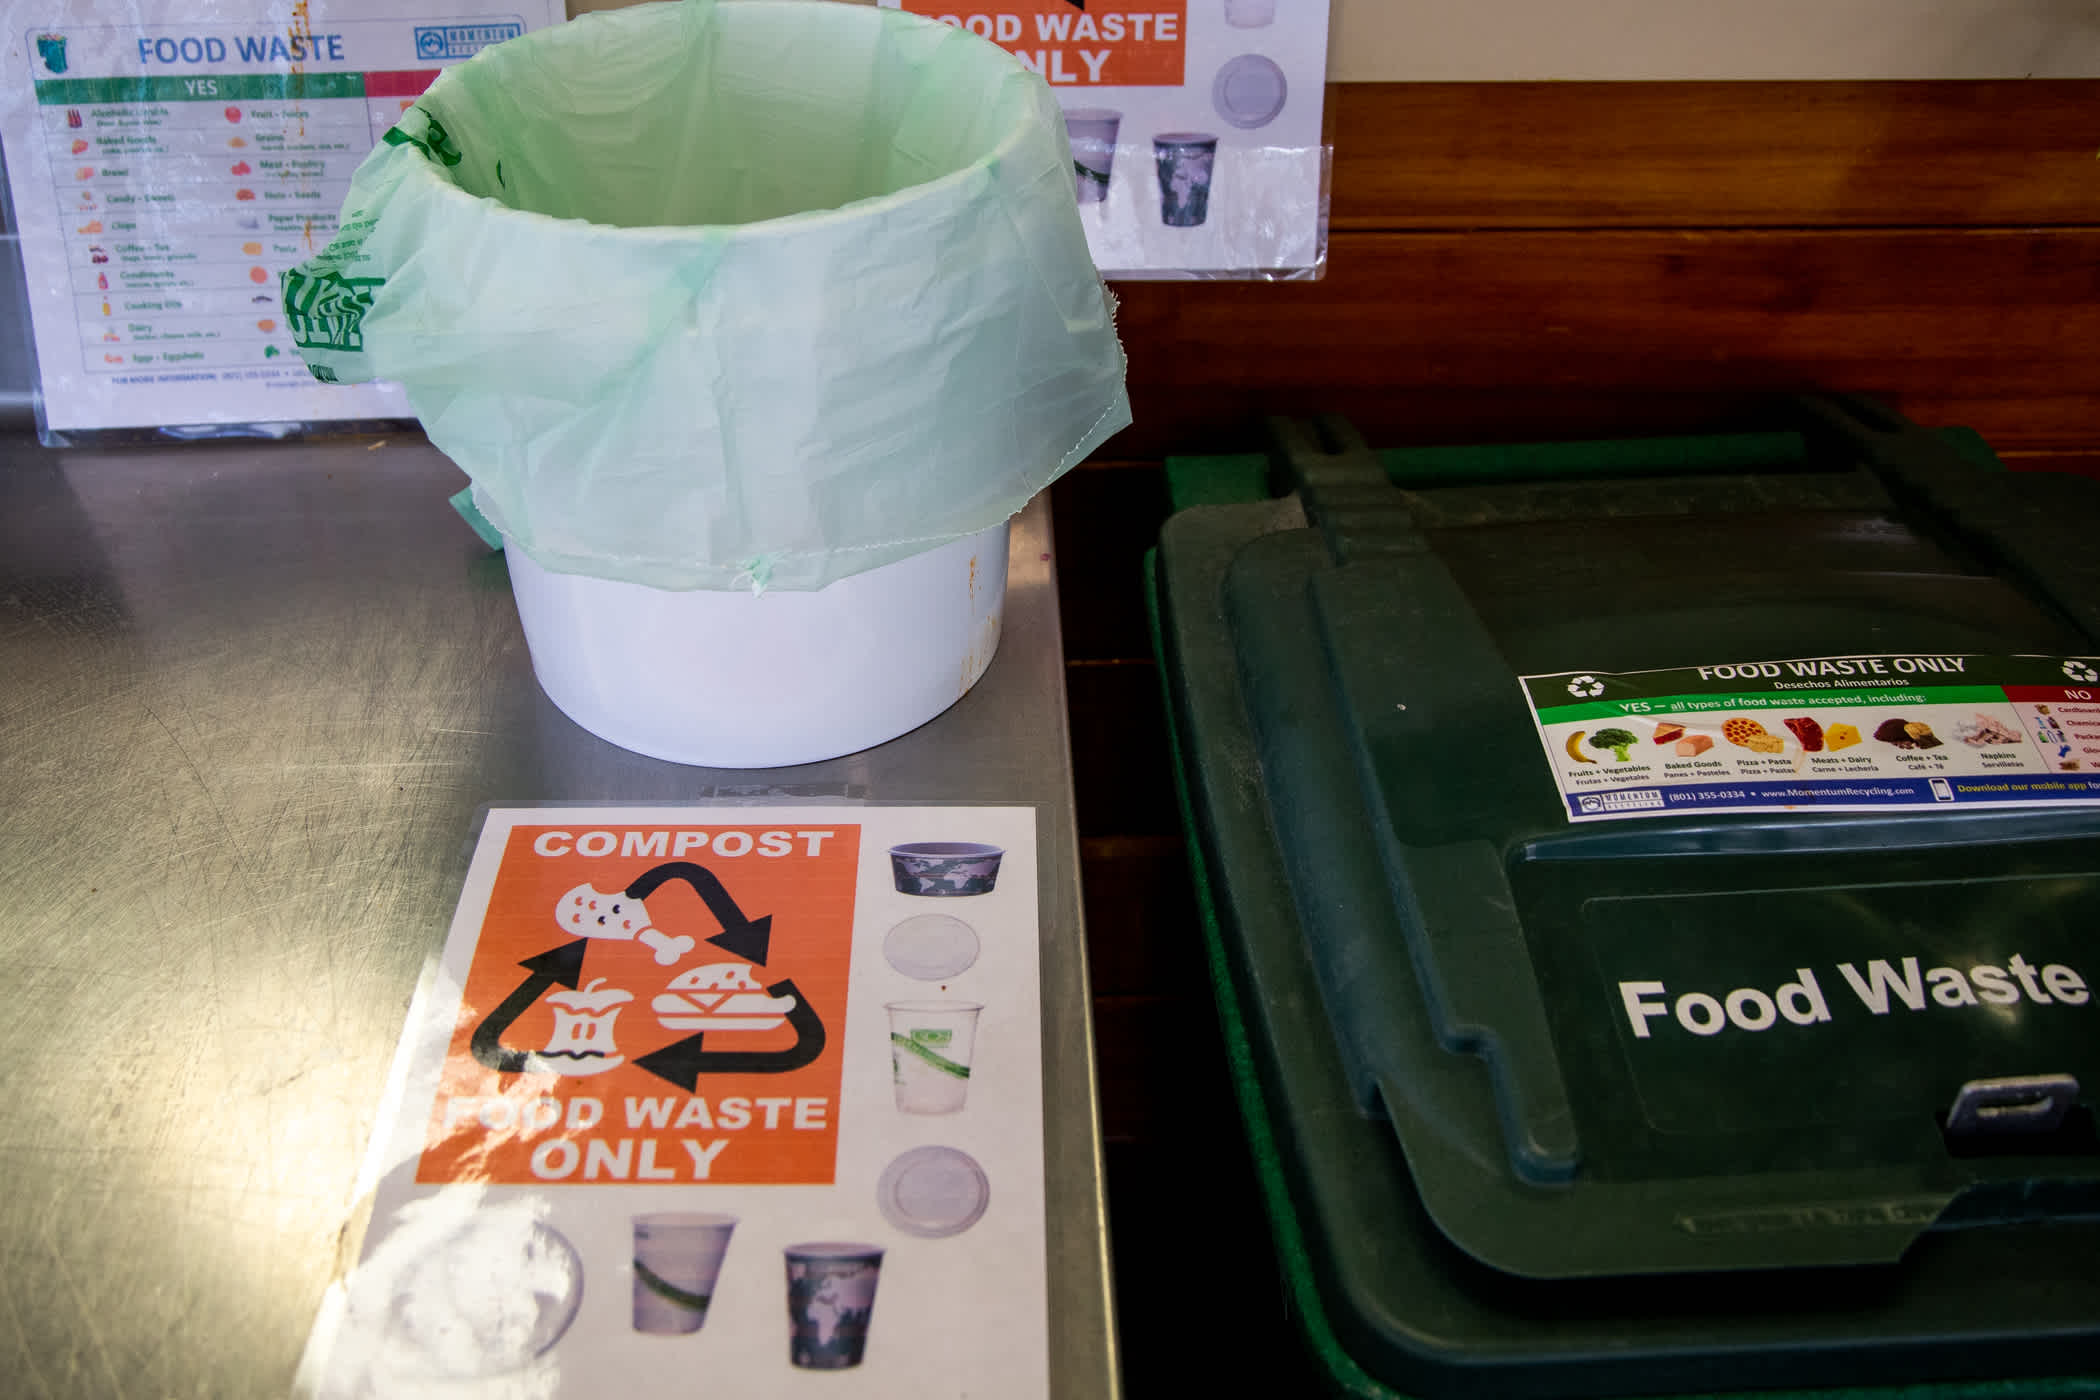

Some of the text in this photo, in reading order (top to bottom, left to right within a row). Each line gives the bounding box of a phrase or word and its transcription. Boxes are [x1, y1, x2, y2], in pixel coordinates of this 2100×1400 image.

[918, 13, 1179, 42] OD WASTE
[138, 34, 345, 64] FOOD WASTE
[1015, 50, 1111, 83] NLY
[184, 79, 218, 96] YES
[1698, 656, 1966, 681] FOOD WASTE ONLY
[1774, 677, 1909, 690] Desechos Alimentarios
[2064, 689, 2092, 700] NO
[1619, 702, 1651, 713] YES
[1670, 701, 1686, 712] all
[1687, 700, 1721, 711] types
[1724, 698, 1737, 707] of
[1738, 697, 1767, 707] food
[1769, 696, 1805, 706] waste
[1808, 694, 1867, 706] accepted,
[1868, 692, 1927, 704] including:
[1736, 759, 1759, 767] Pizza
[1768, 758, 1792, 766] Pasta
[1811, 757, 1838, 765] Meats
[1849, 756, 1872, 765] Dairy
[1896, 754, 1924, 763] Coffee
[1980, 752, 2017, 762] Napkins
[1568, 768, 1595, 778] Fruits
[1602, 764, 1651, 775] Vegetables
[1665, 760, 1722, 770] Baked Goods
[1812, 766, 1836, 774] Carne
[1576, 777, 1602, 786] Frutas
[1957, 783, 2009, 793] Download
[2011, 784, 2029, 792] our
[2031, 782, 2065, 791] mobile
[2068, 783, 2087, 792] app
[1605, 791, 1659, 801] MOMENTUM
[1669, 793, 1697, 802] (801)
[1698, 791, 1745, 801] 355-0334
[1761, 786, 1915, 799] www.MomentumRecycling.com
[533, 829, 835, 857] COMPOST
[1618, 952, 2090, 1039] Food Waste
[442, 1095, 828, 1131] FOOD WASTE
[530, 1138, 729, 1182] ONLY
